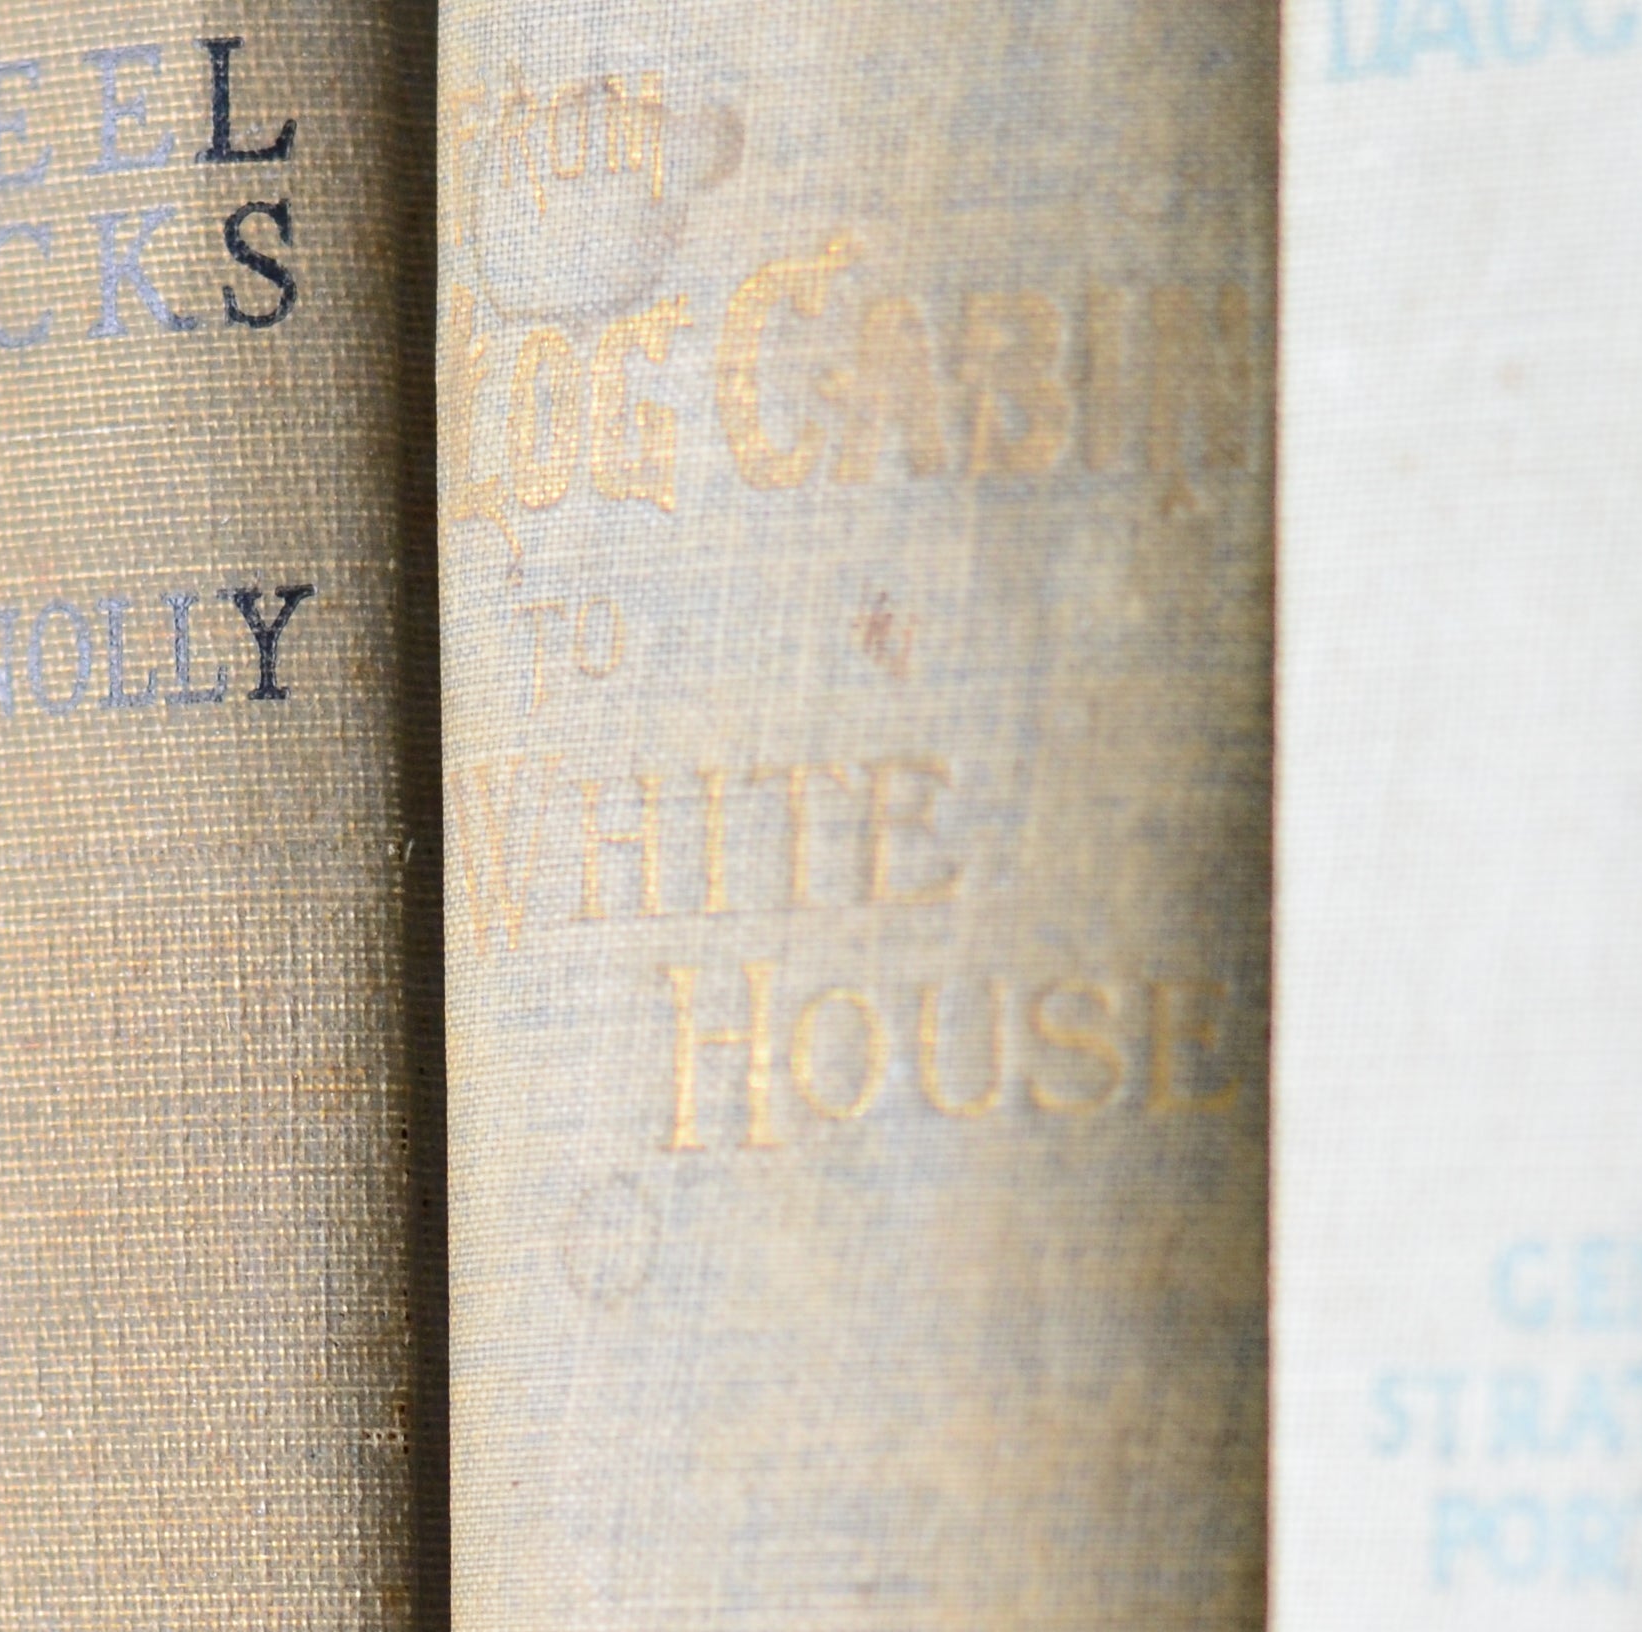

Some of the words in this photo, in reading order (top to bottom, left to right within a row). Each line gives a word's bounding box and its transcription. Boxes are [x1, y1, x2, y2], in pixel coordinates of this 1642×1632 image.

[511, 597, 625, 706] TO
[447, 750, 963, 953] WHITE
[661, 958, 1241, 1153] HOUSE
